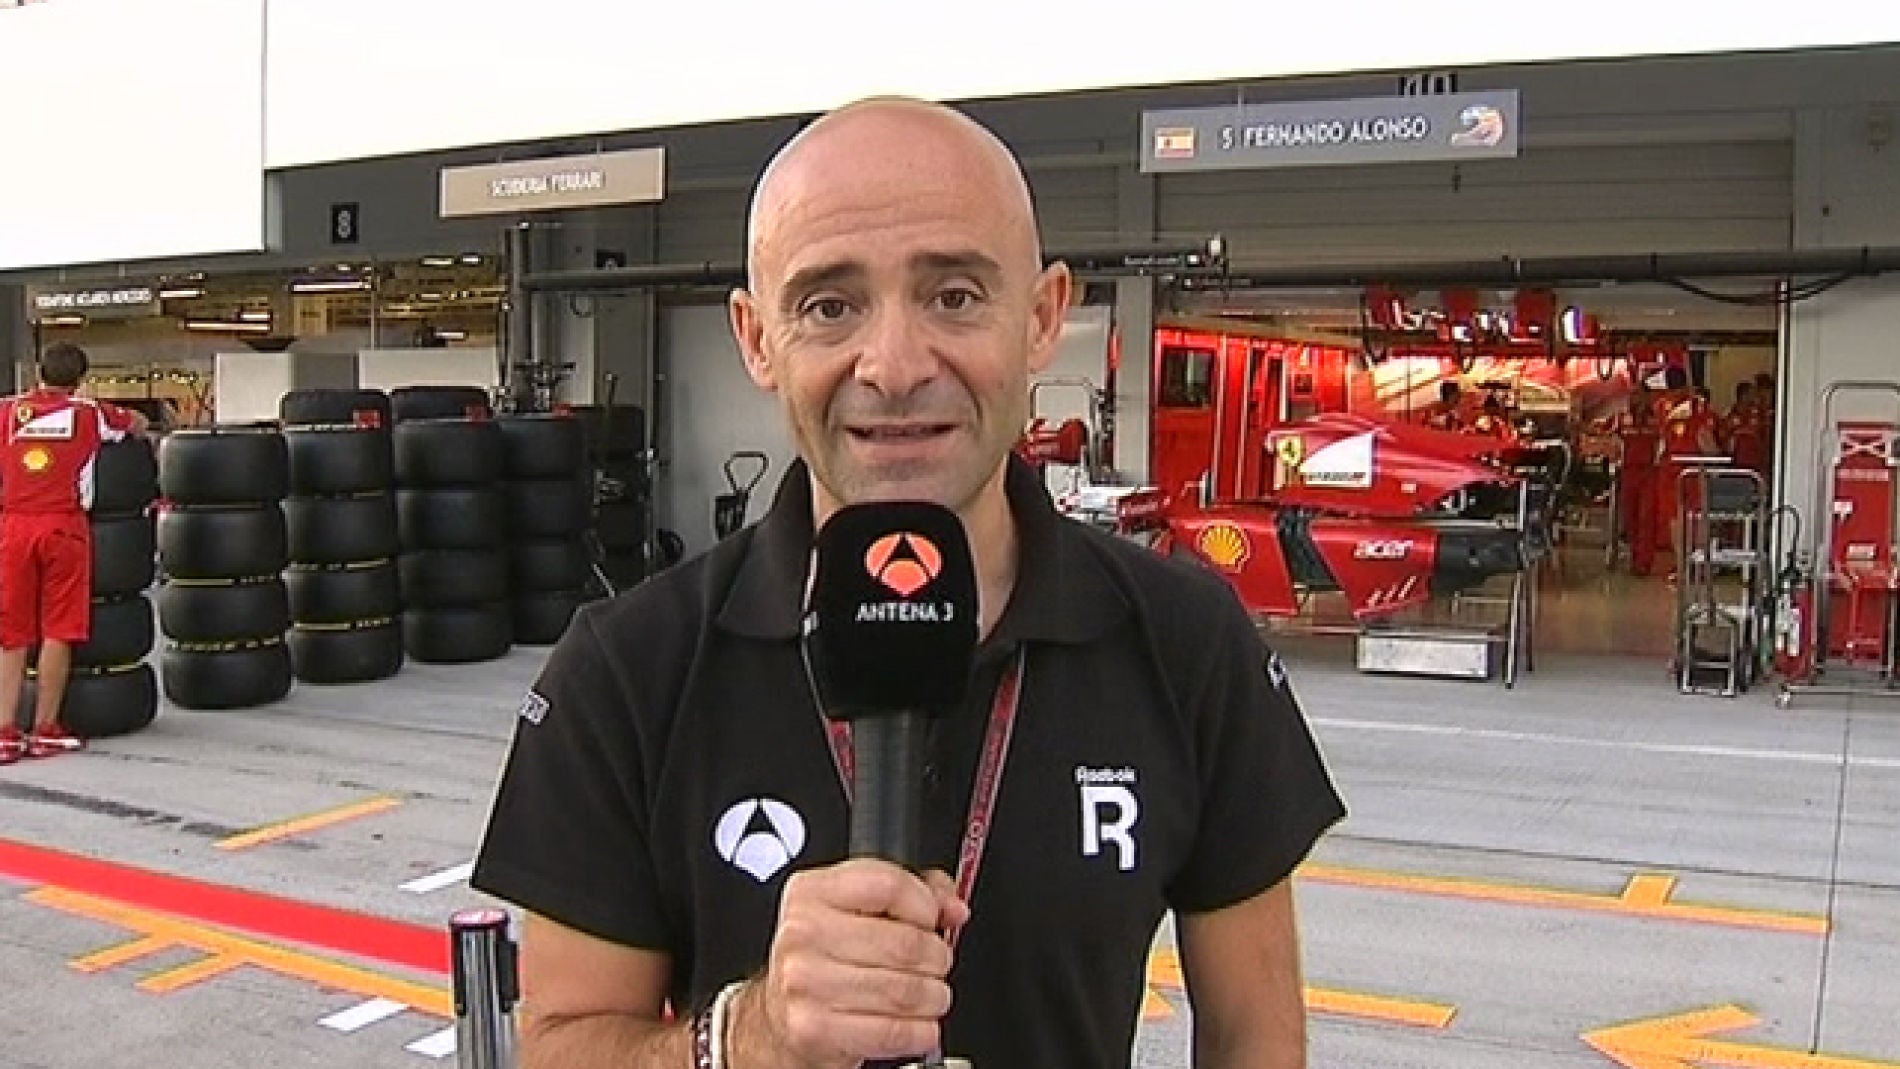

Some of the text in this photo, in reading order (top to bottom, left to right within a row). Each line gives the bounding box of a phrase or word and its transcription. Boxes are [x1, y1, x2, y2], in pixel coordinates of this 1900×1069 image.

[1244, 120, 1345, 148] FERNANDO
[1350, 114, 1428, 143] ALONSO
[338, 210, 351, 239] 8
[1354, 539, 1414, 558] acer
[855, 601, 954, 621] ANTENA 3
